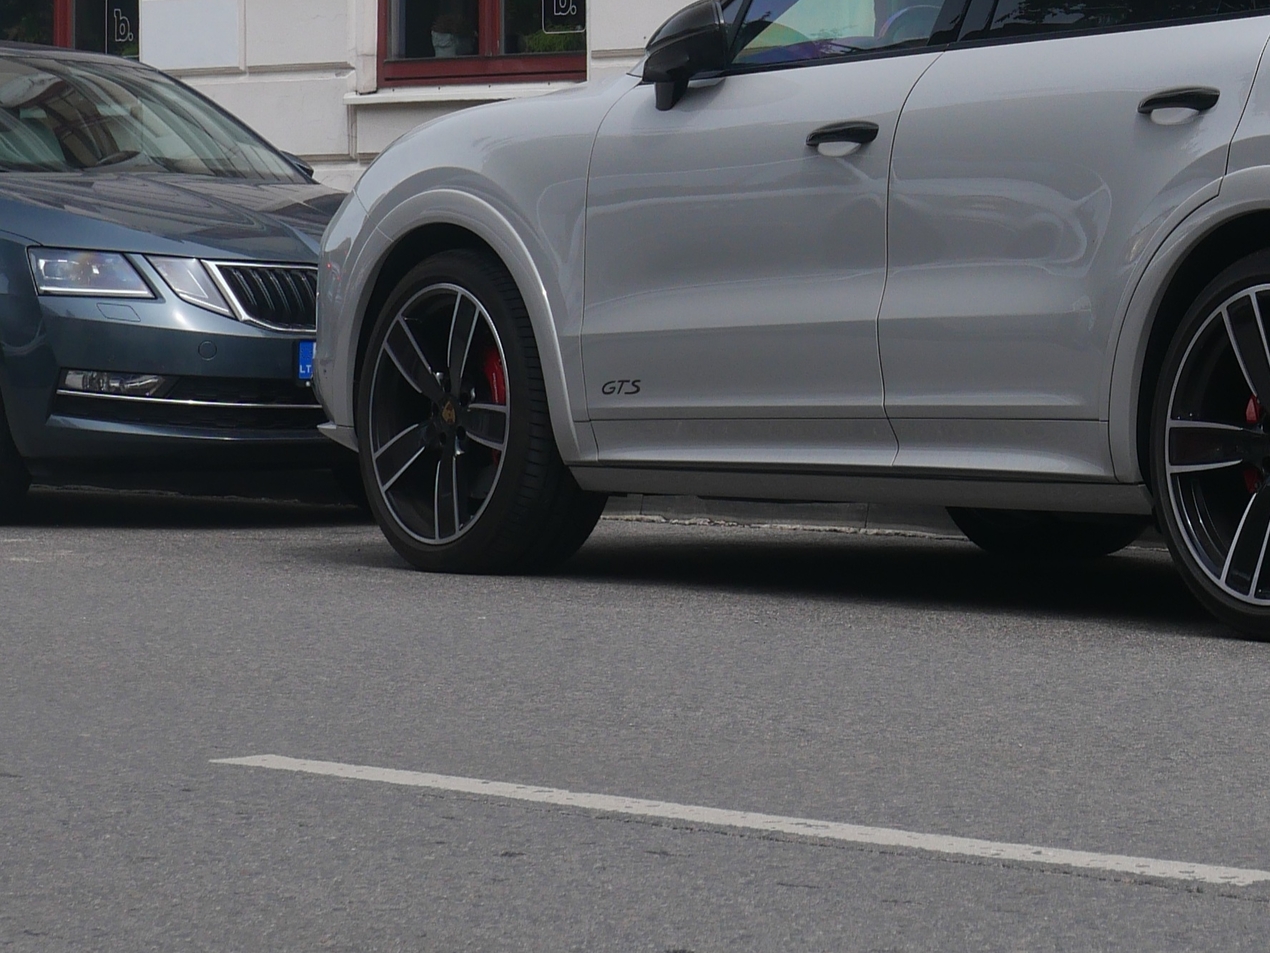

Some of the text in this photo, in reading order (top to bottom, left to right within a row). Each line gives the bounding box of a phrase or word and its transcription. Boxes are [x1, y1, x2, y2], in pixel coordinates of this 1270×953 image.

[113, 8, 134, 42] b.
[299, 364, 312, 374] LT
[601, 379, 641, 395] GTS
